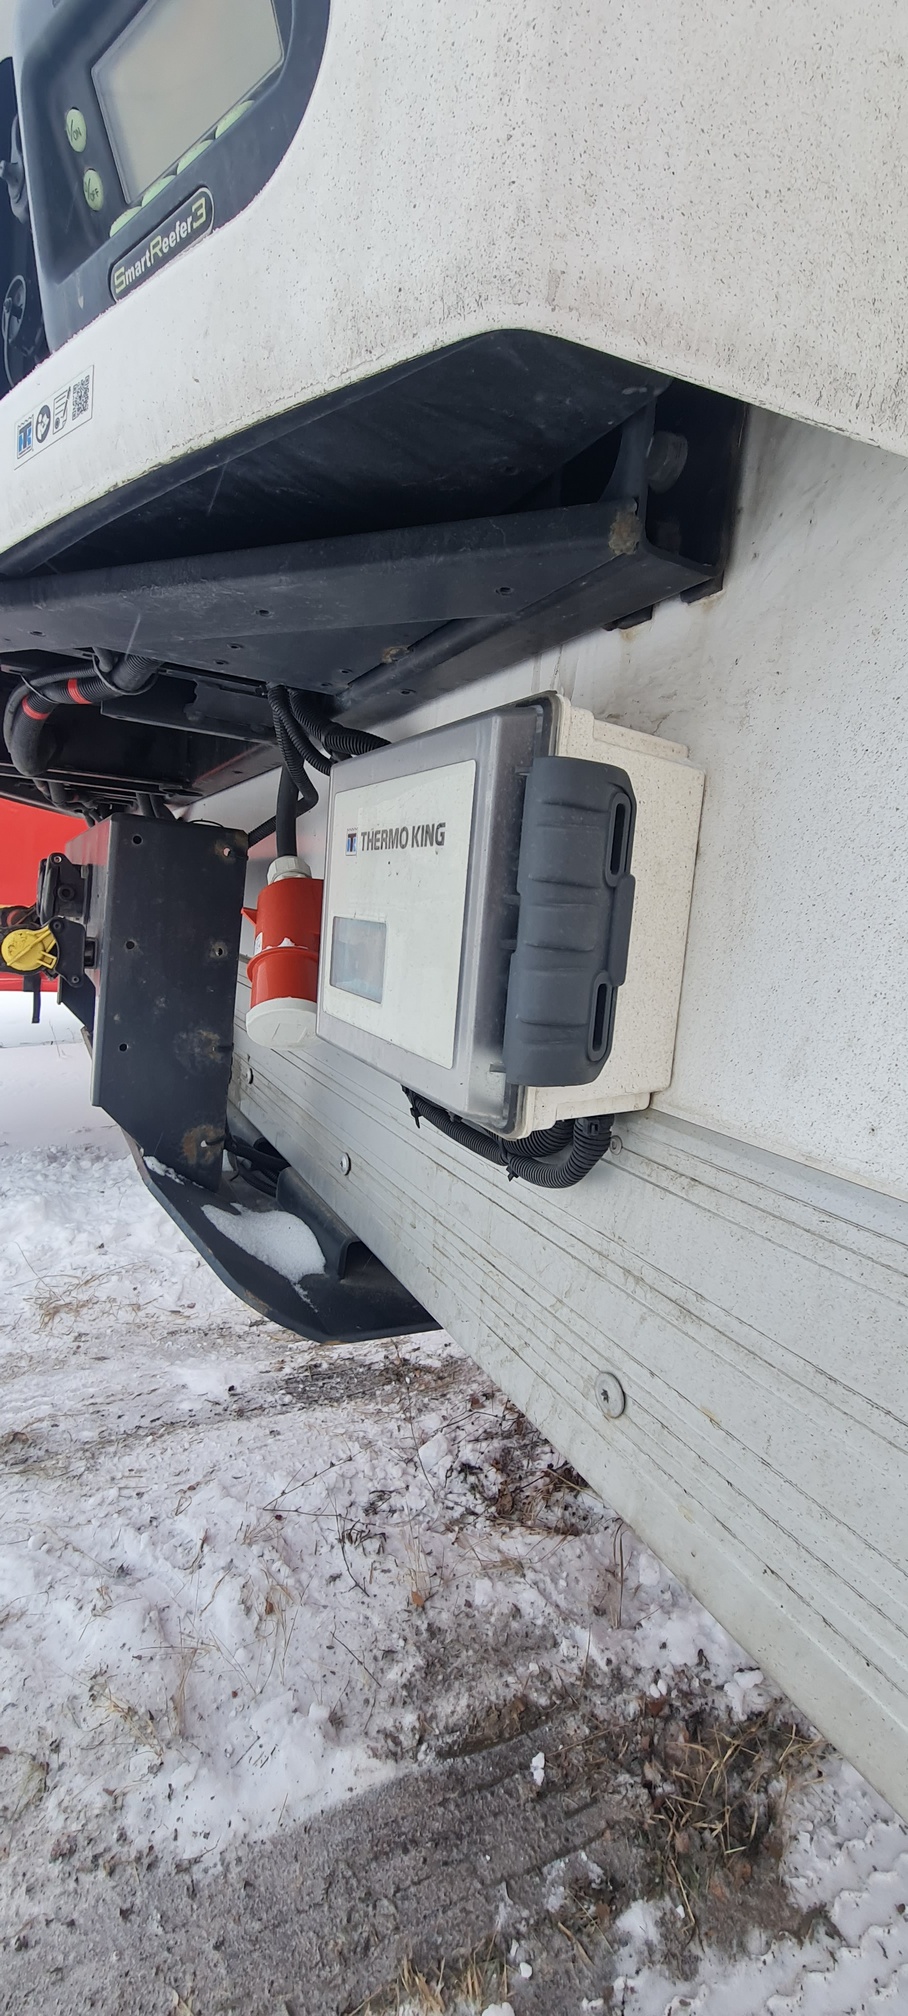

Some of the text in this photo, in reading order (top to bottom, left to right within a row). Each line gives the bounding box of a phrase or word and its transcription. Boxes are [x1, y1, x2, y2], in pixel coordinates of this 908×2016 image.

[114, 197, 207, 294] SmartReefer3
[360, 826, 409, 851] THERMO
[411, 822, 446, 848] KING
